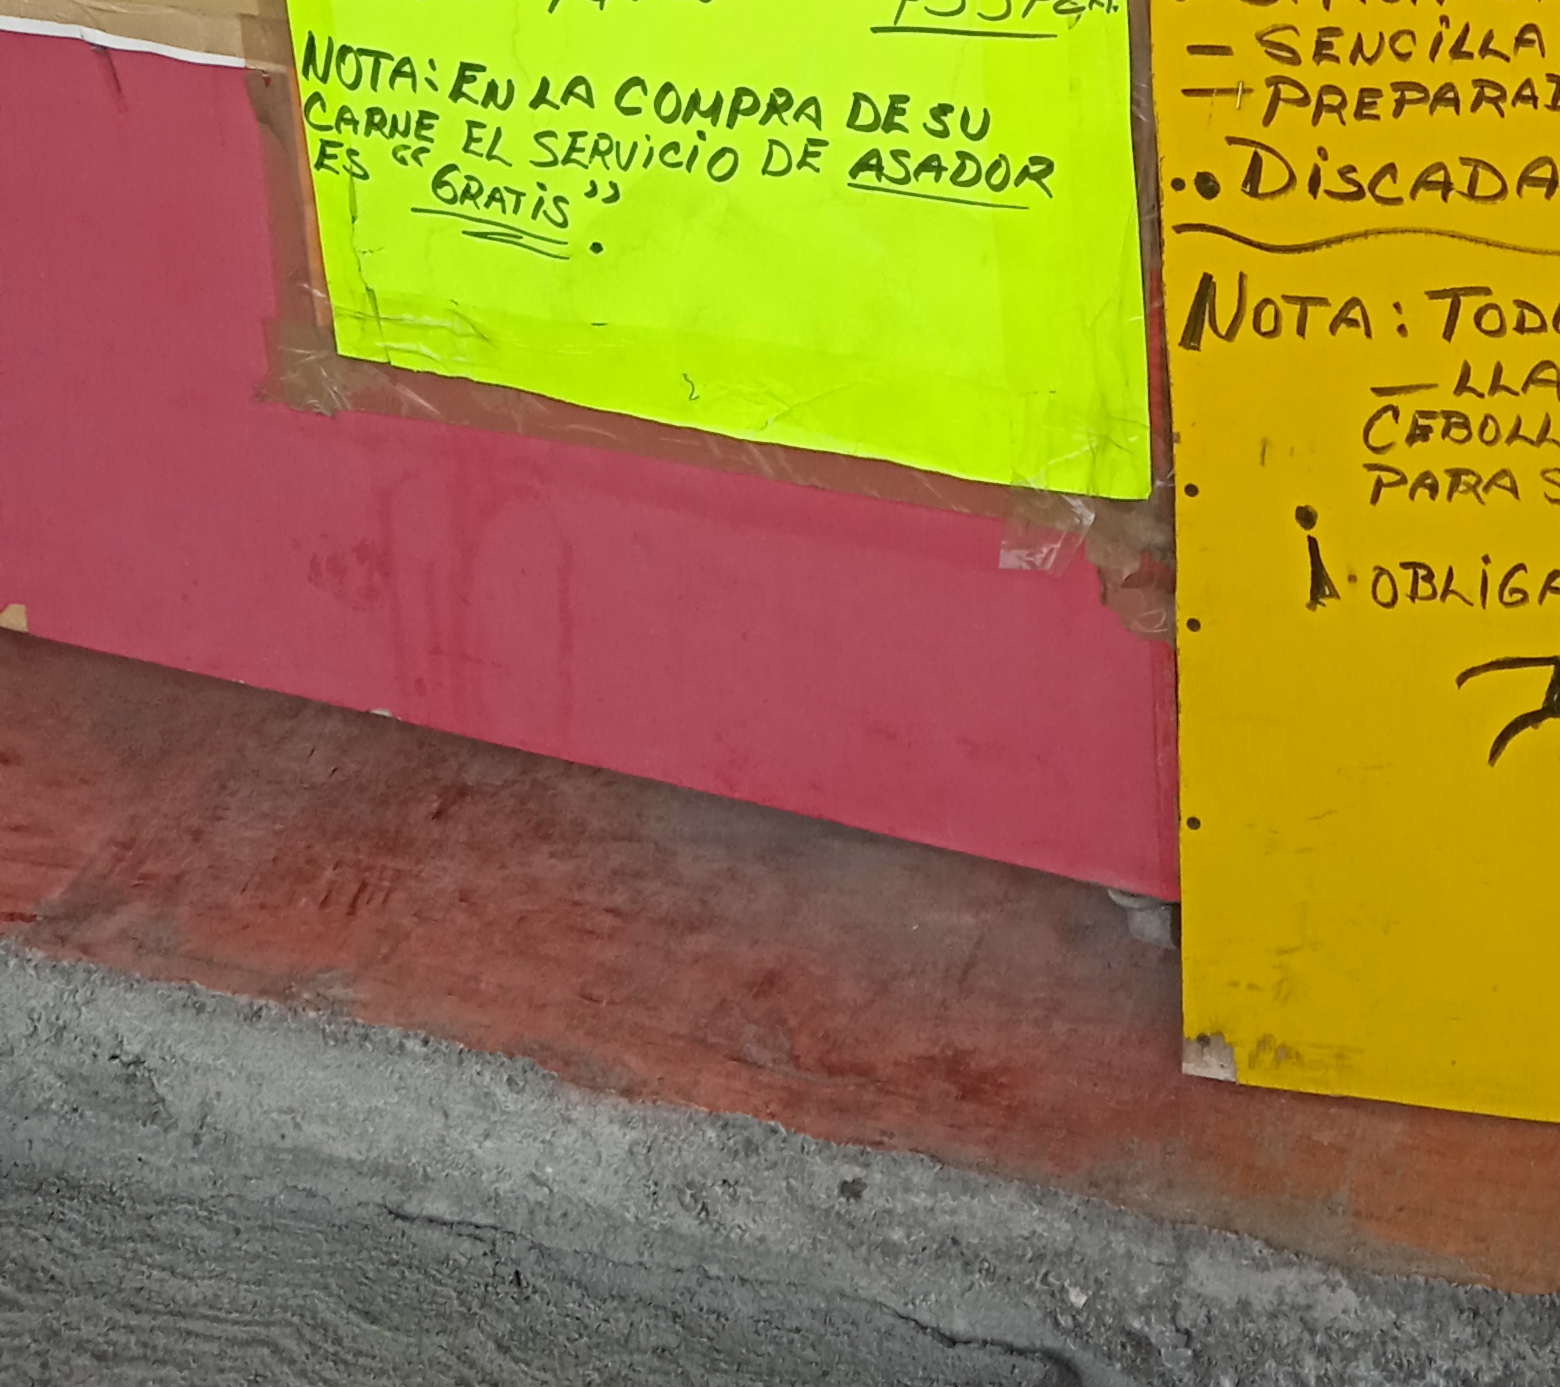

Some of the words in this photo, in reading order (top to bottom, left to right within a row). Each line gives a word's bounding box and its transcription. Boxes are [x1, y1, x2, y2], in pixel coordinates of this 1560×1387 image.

[1256, 14, 1547, 66] SENCILLA
[301, 30, 440, 96] NOTA:
[448, 61, 515, 112] EN
[529, 75, 596, 111] LA
[614, 75, 822, 132] COMPRA
[846, 91, 911, 134] DE
[922, 101, 991, 142] SU
[303, 90, 440, 143] CARNE
[462, 119, 513, 167] EL
[530, 129, 740, 183] SERVICIO
[762, 137, 830, 178] DE
[848, 148, 1054, 199] ASADOR
[313, 138, 371, 181] ES
[1225, 135, 1560, 205] DISCADA
[1362, 462, 1521, 506] PARA
